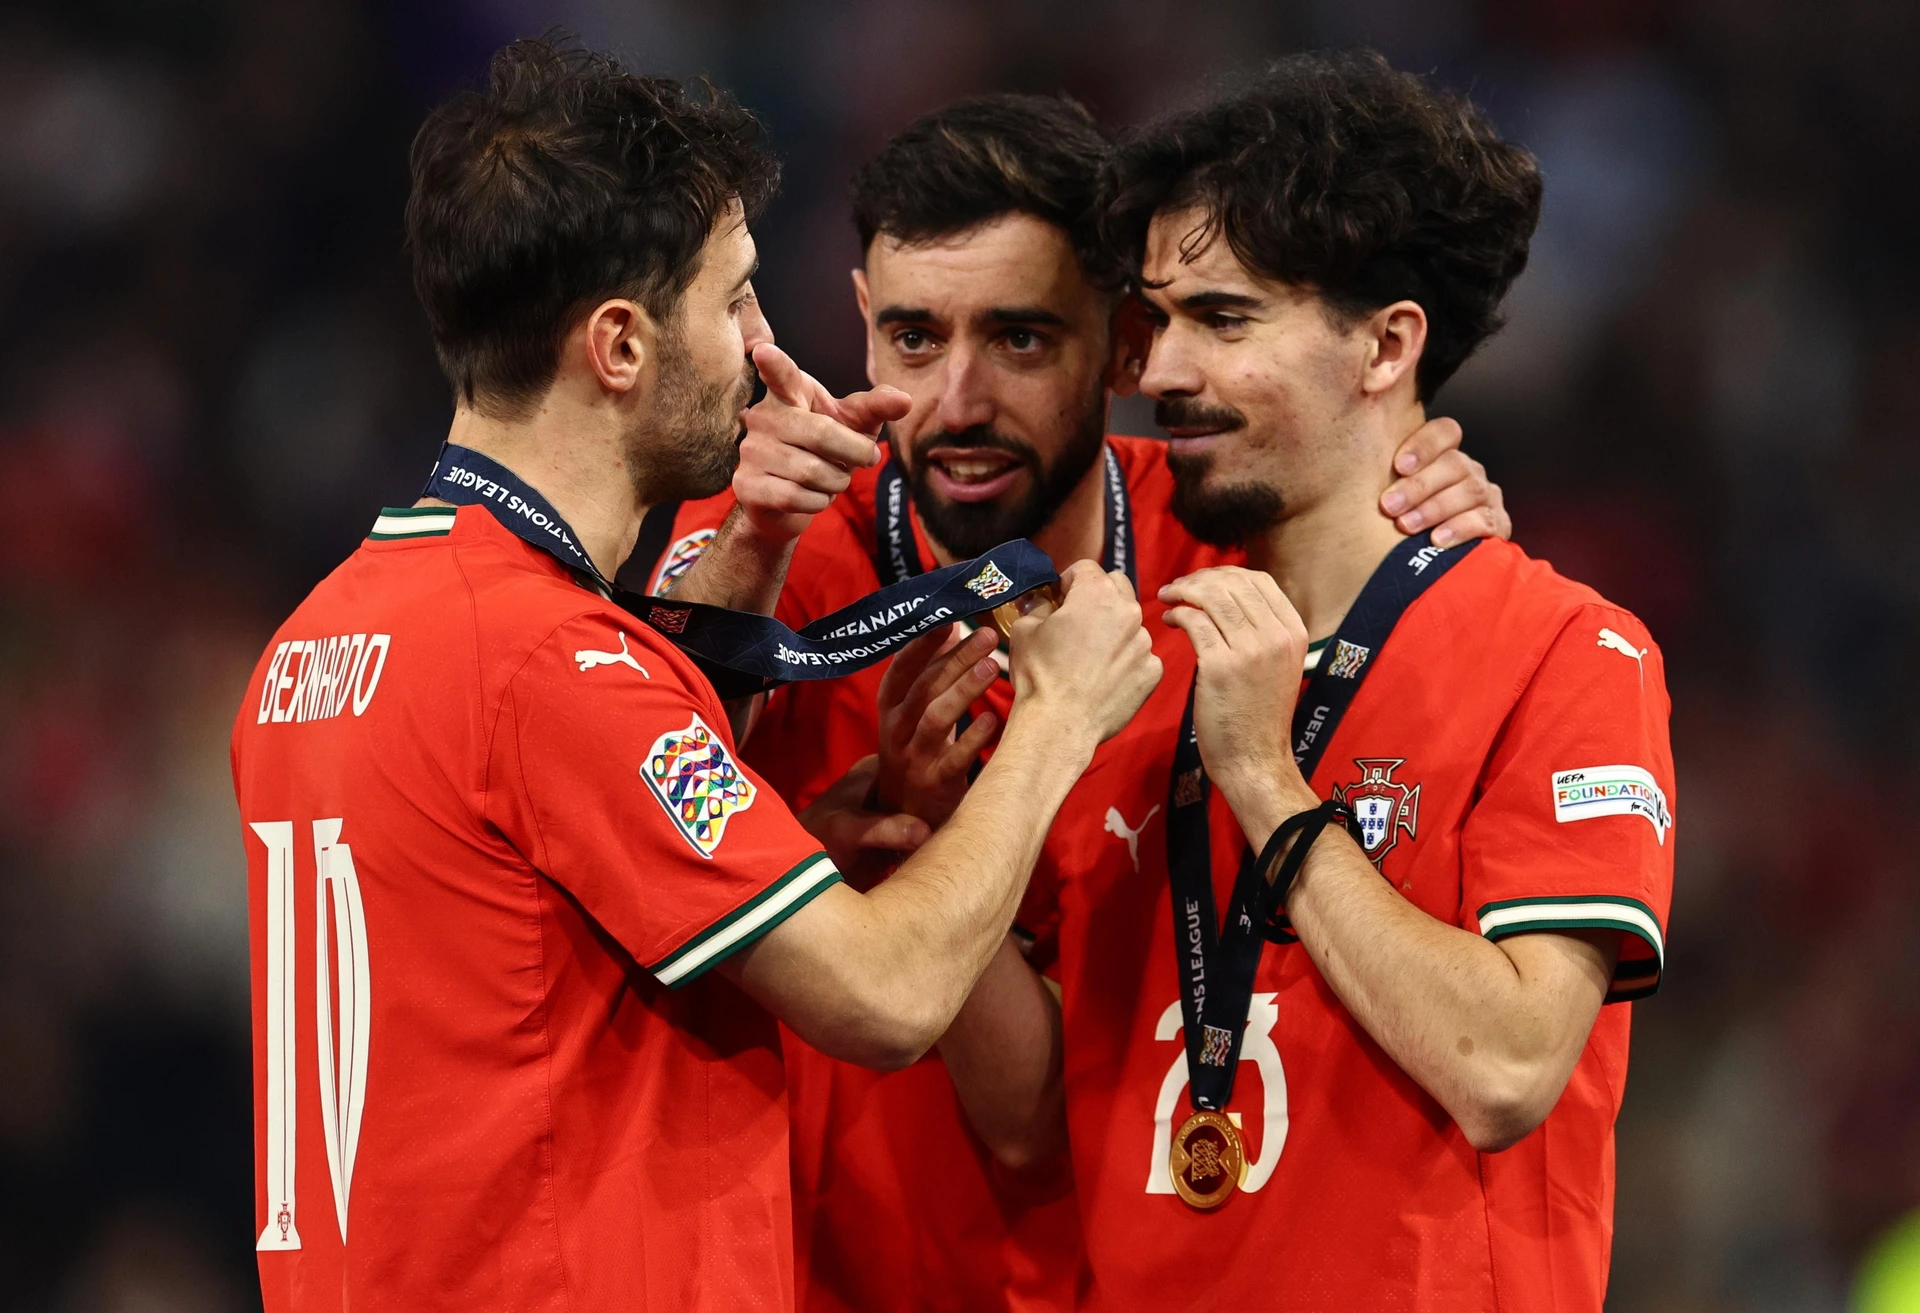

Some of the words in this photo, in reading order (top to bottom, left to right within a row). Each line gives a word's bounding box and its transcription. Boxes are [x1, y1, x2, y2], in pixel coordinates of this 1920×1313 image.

[447, 466, 509, 502] LEAGUE
[888, 478, 902, 530] UEFA
[507, 495, 582, 557] NATIONS
[869, 594, 930, 631] NATIO
[904, 606, 954, 633] UEFA
[778, 642, 832, 667] LEAGUE
[827, 631, 908, 664] NATIONS
[256, 633, 391, 725] BERNARDO
[1294, 705, 1330, 753] UEFA
[1557, 773, 1585, 785] UEFA
[1186, 900, 1205, 982] LEAGUE
[249, 817, 371, 1251] 10
[1145, 992, 1289, 1194] 23
